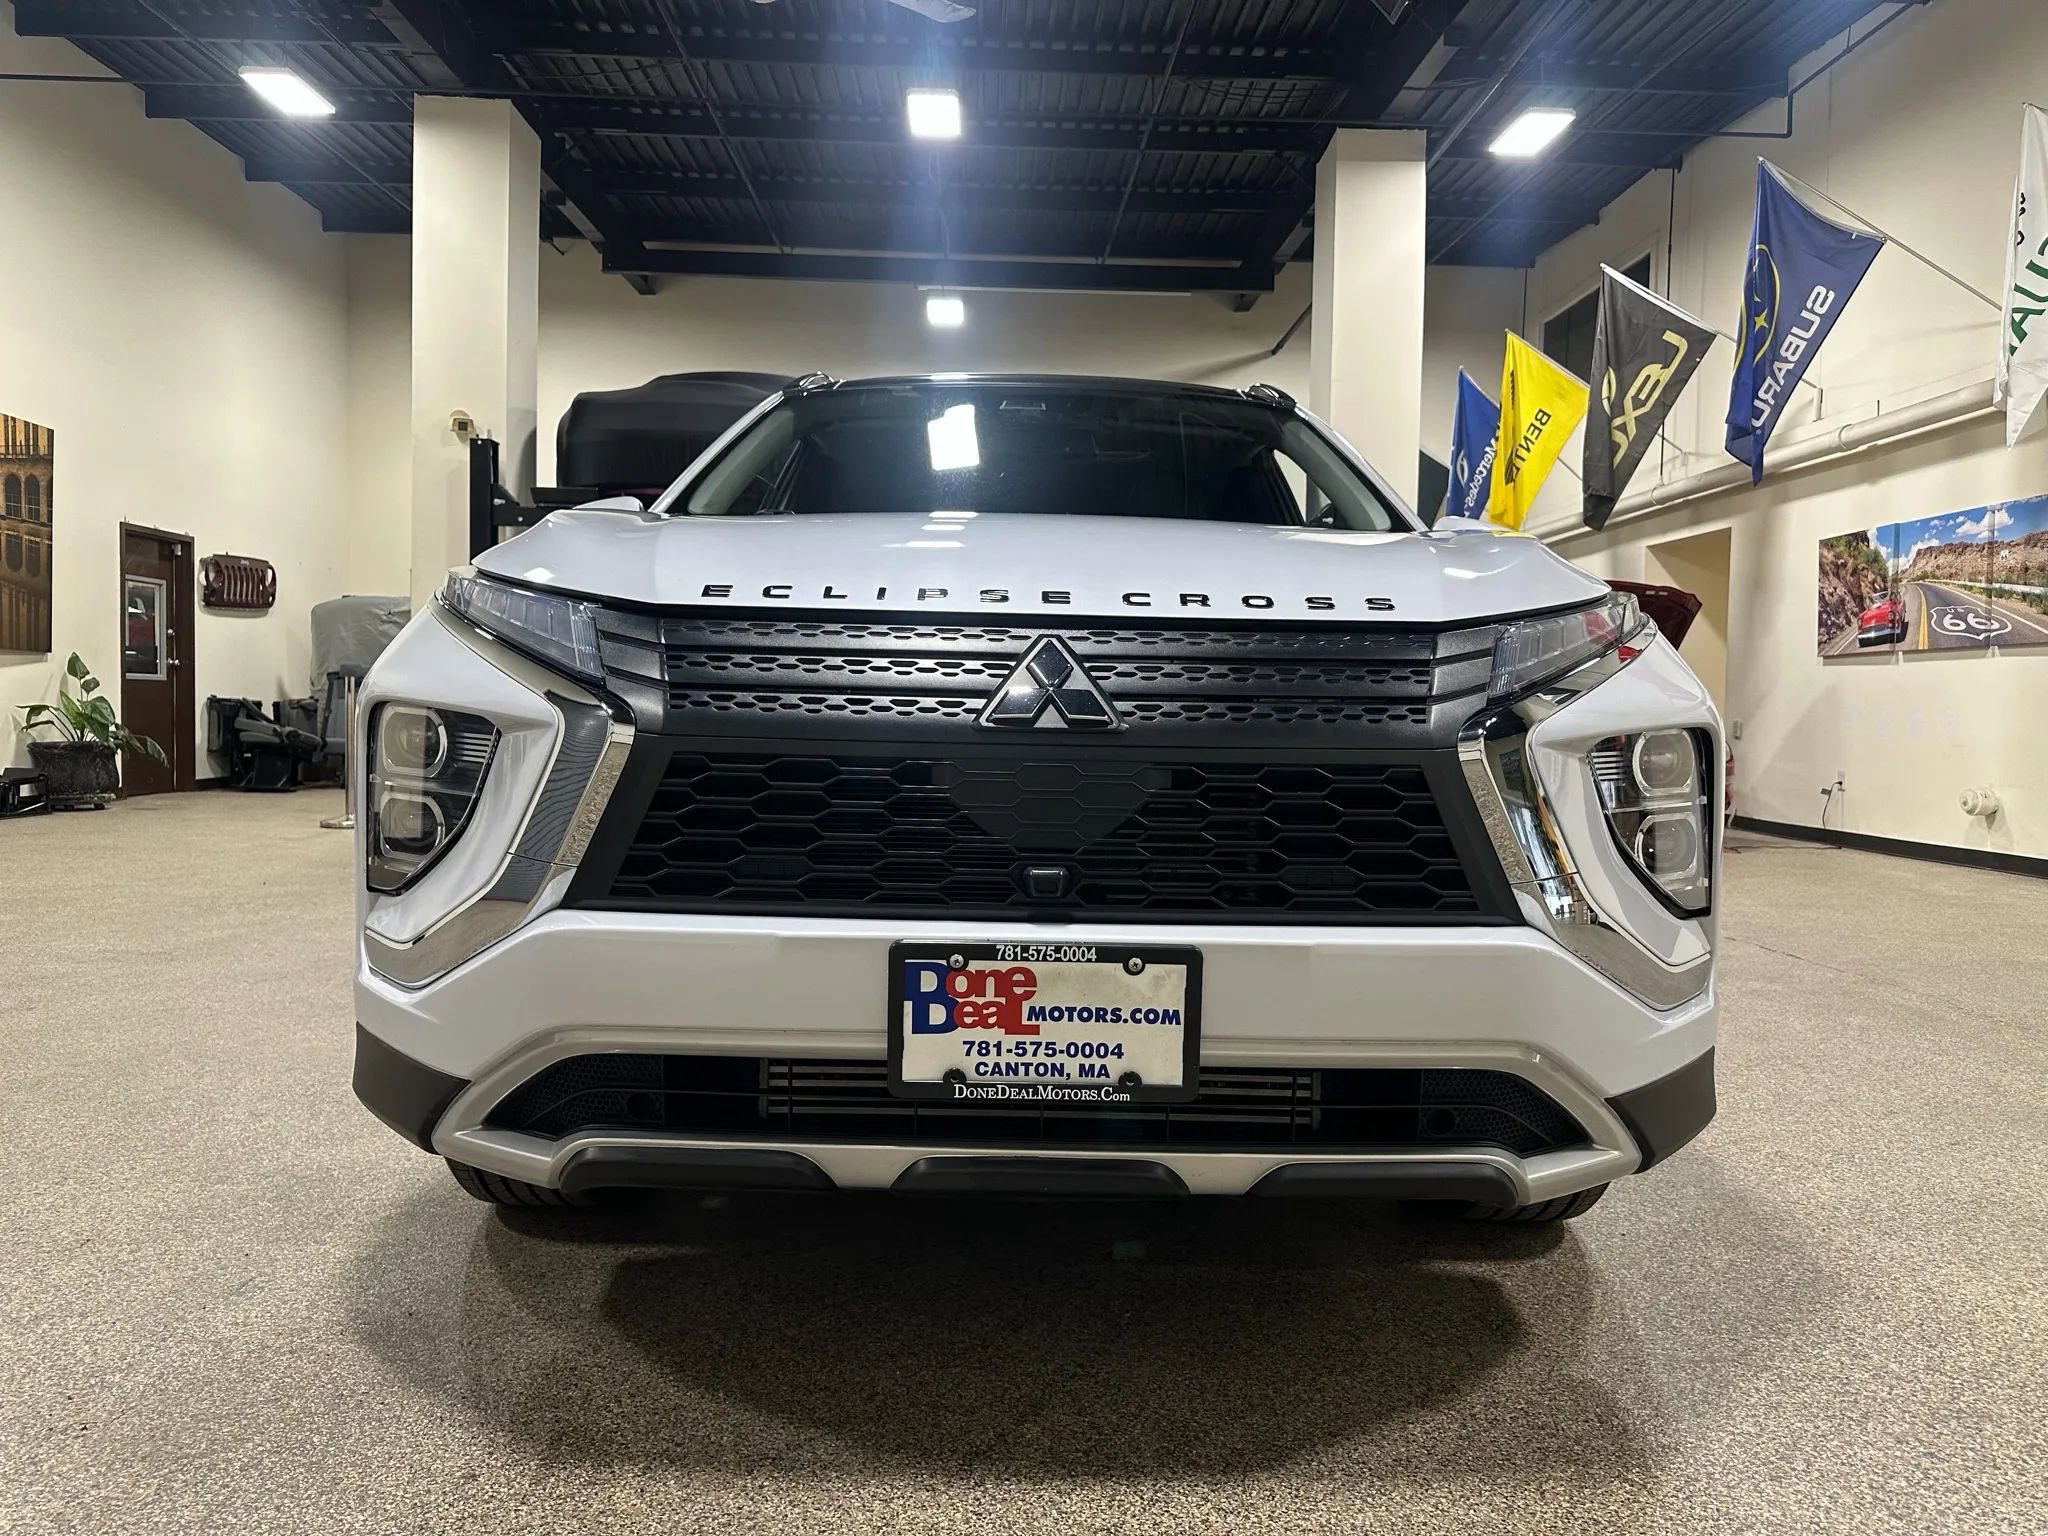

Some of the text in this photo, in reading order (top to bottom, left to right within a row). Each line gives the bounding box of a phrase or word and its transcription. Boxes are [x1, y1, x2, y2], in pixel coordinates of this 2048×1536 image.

[700, 583, 1396, 612] ECLIPSE CROSS
[1942, 612, 2001, 631] 66
[995, 944, 1097, 962] 781-575-0004
[904, 960, 1038, 1002] Done
[1026, 1004, 1182, 1026] MOTORS.COM
[962, 1040, 1125, 1060] 781-575-0004
[974, 1061, 1111, 1081] CANTON, MA
